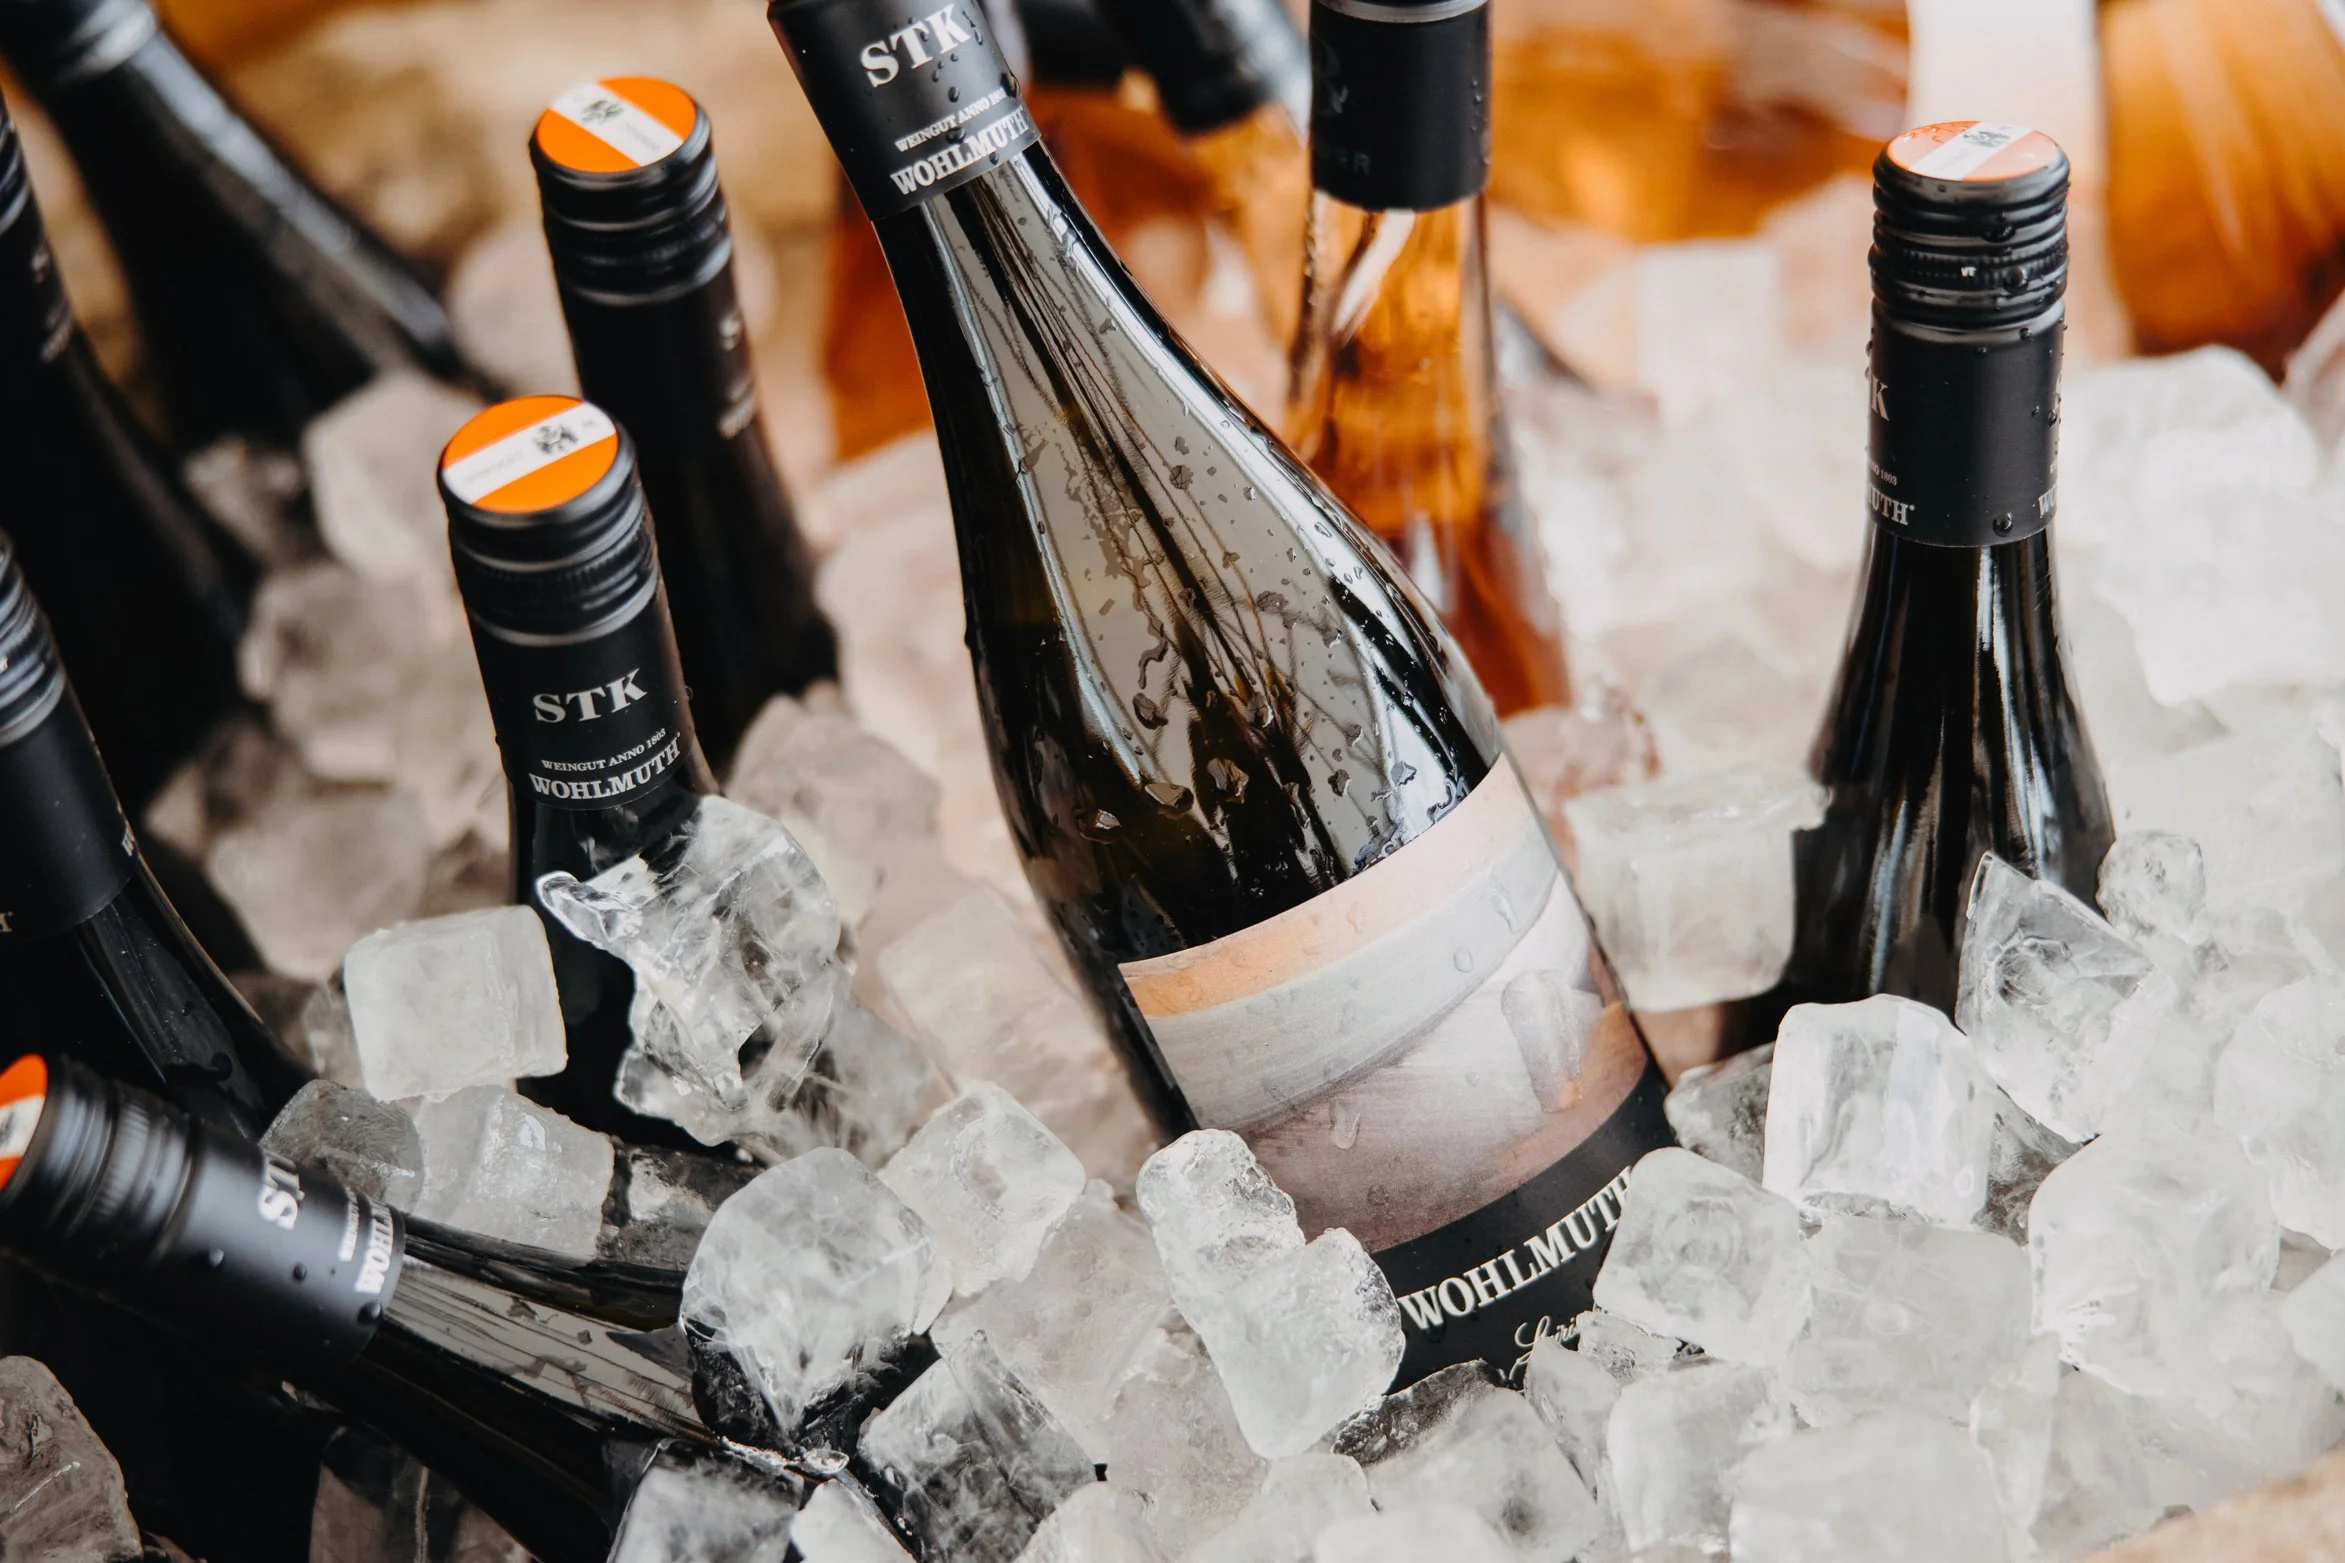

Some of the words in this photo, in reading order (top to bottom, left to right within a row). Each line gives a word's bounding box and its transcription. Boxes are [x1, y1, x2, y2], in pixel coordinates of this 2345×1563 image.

[860, 3, 972, 88] STK
[889, 106, 1030, 195] WOHLMUTH
[894, 114, 959, 153] WEINGUT
[957, 98, 991, 124] ANNO
[532, 667, 648, 724] STK
[528, 736, 681, 800] WOHLMUTH
[541, 759, 606, 772] WEINGUT
[608, 744, 645, 767] ANNO
[645, 728, 667, 749] 1803
